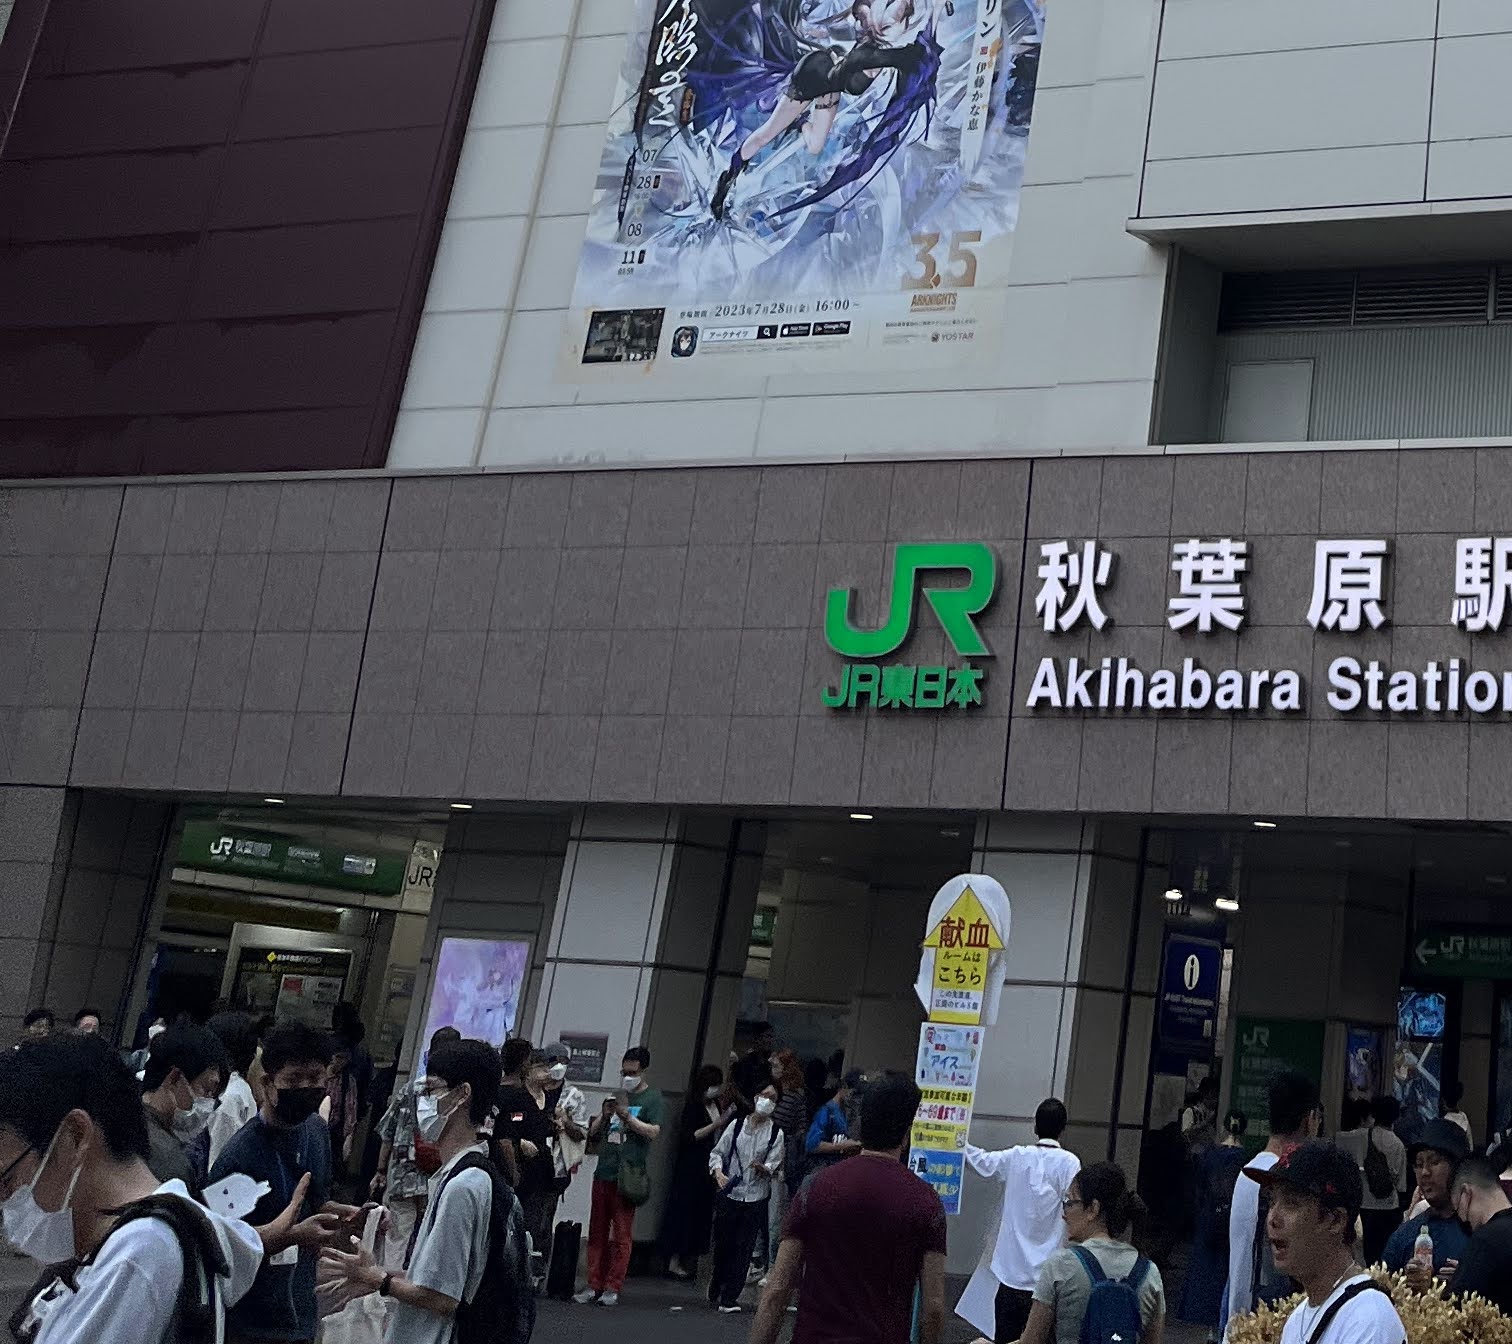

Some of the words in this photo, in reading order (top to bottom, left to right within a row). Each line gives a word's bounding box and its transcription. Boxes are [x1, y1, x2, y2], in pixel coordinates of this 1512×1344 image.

[643, 149, 658, 163] 07
[636, 175, 652, 189] 28
[627, 223, 642, 237] 08
[621, 250, 635, 264] 11
[901, 229, 983, 290] 3.5
[910, 292, 958, 308] ARKNIGHTS
[940, 331, 975, 342] YOSTAR
[824, 541, 997, 657] JR
[820, 663, 984, 711] JR東日本
[1026, 657, 1302, 712] Akihabara
[209, 836, 234, 856] JR
[939, 915, 991, 949] 献血
[938, 966, 982, 986] こちら
[930, 1054, 960, 1070] アイス
